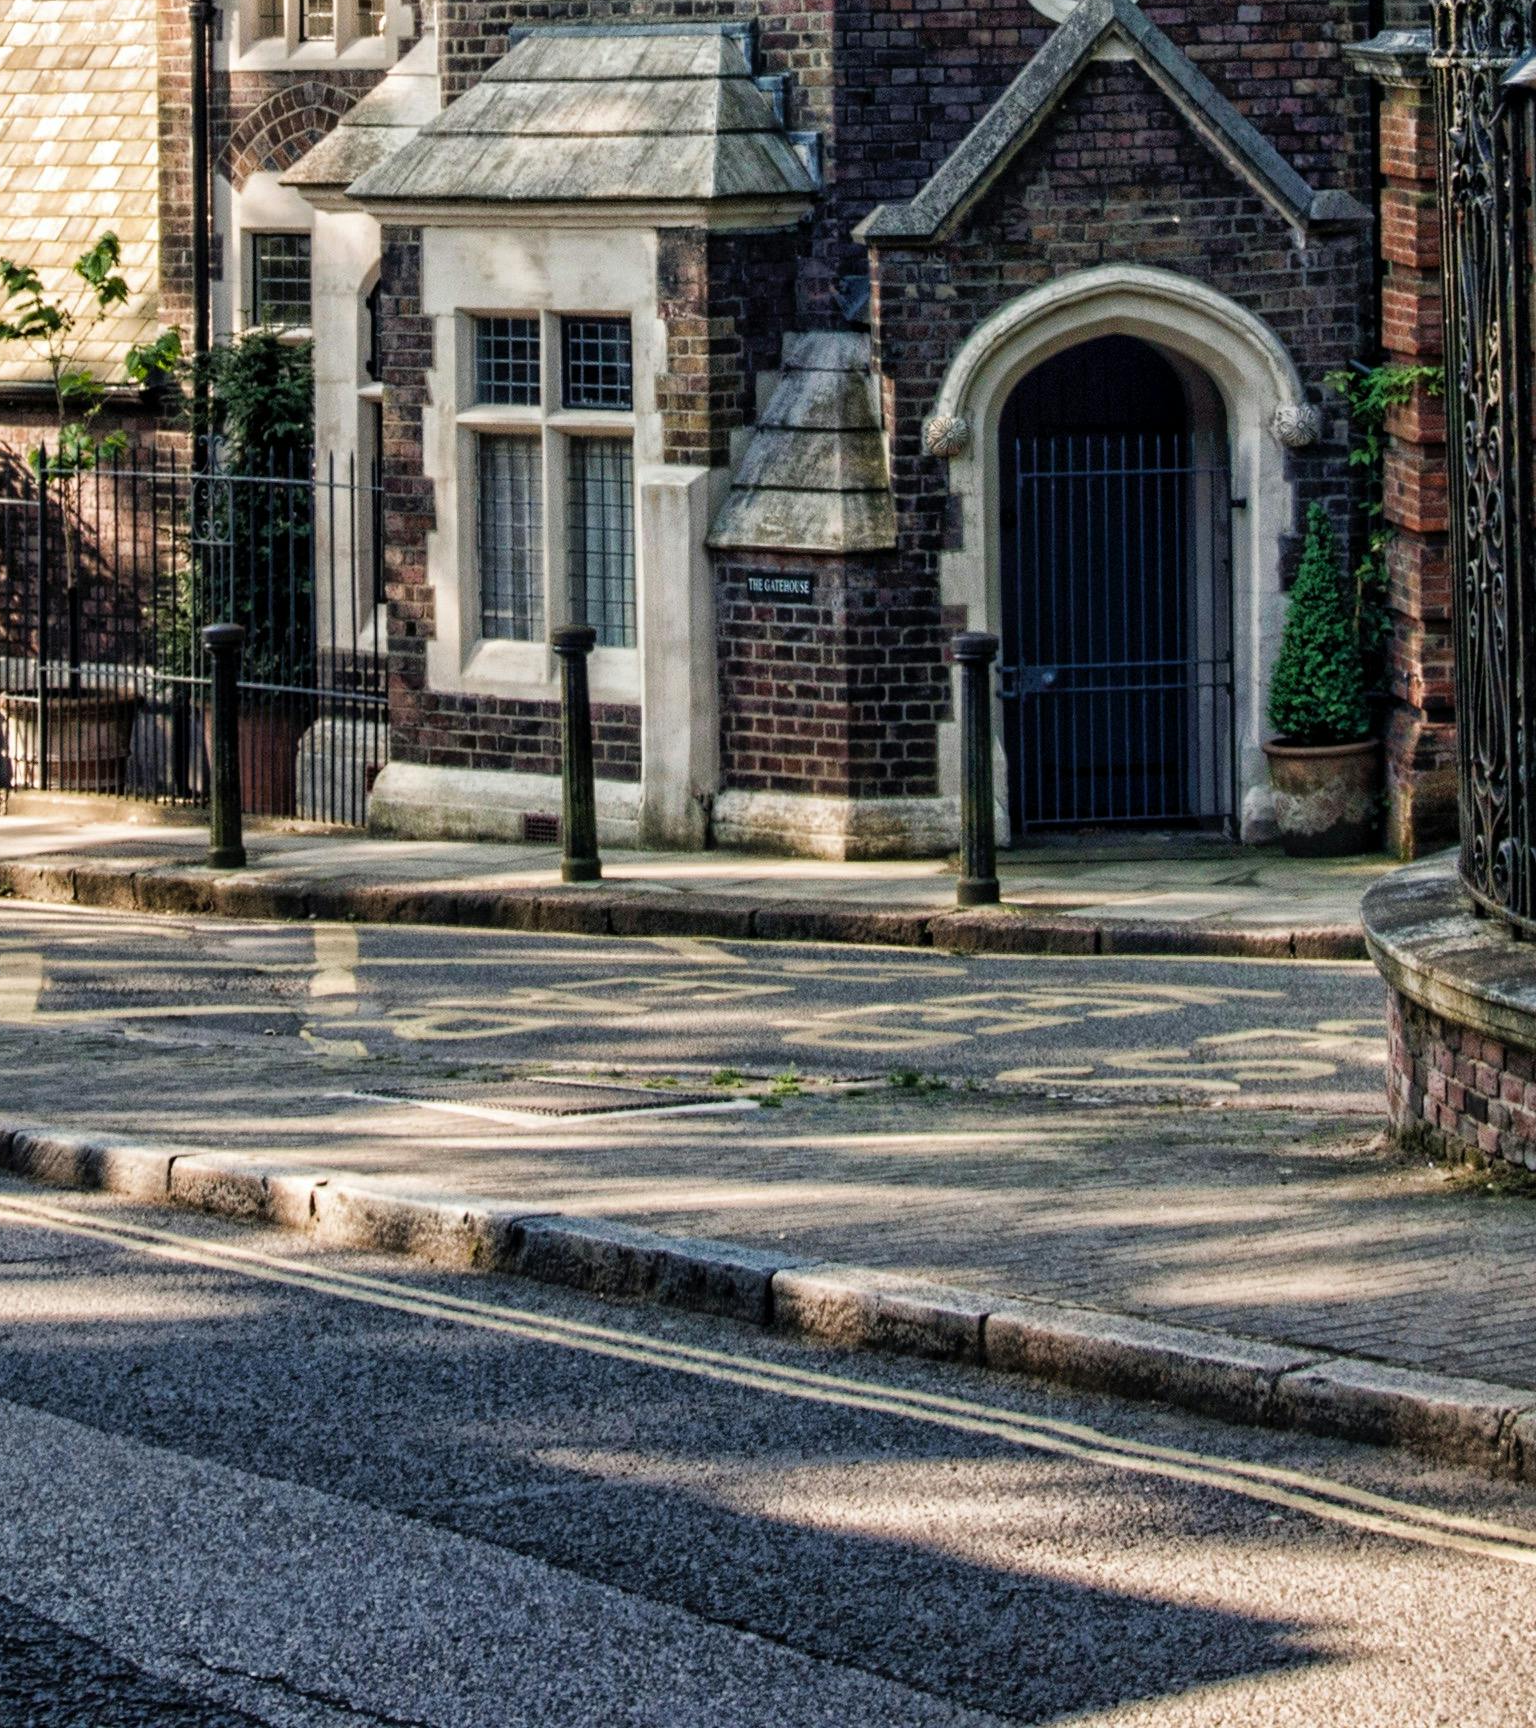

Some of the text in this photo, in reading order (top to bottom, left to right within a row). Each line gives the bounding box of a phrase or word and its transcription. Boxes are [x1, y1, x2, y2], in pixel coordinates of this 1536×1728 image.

[748, 577, 810, 594] THE GATEHOUSE
[767, 981, 1287, 1050] KEEP
